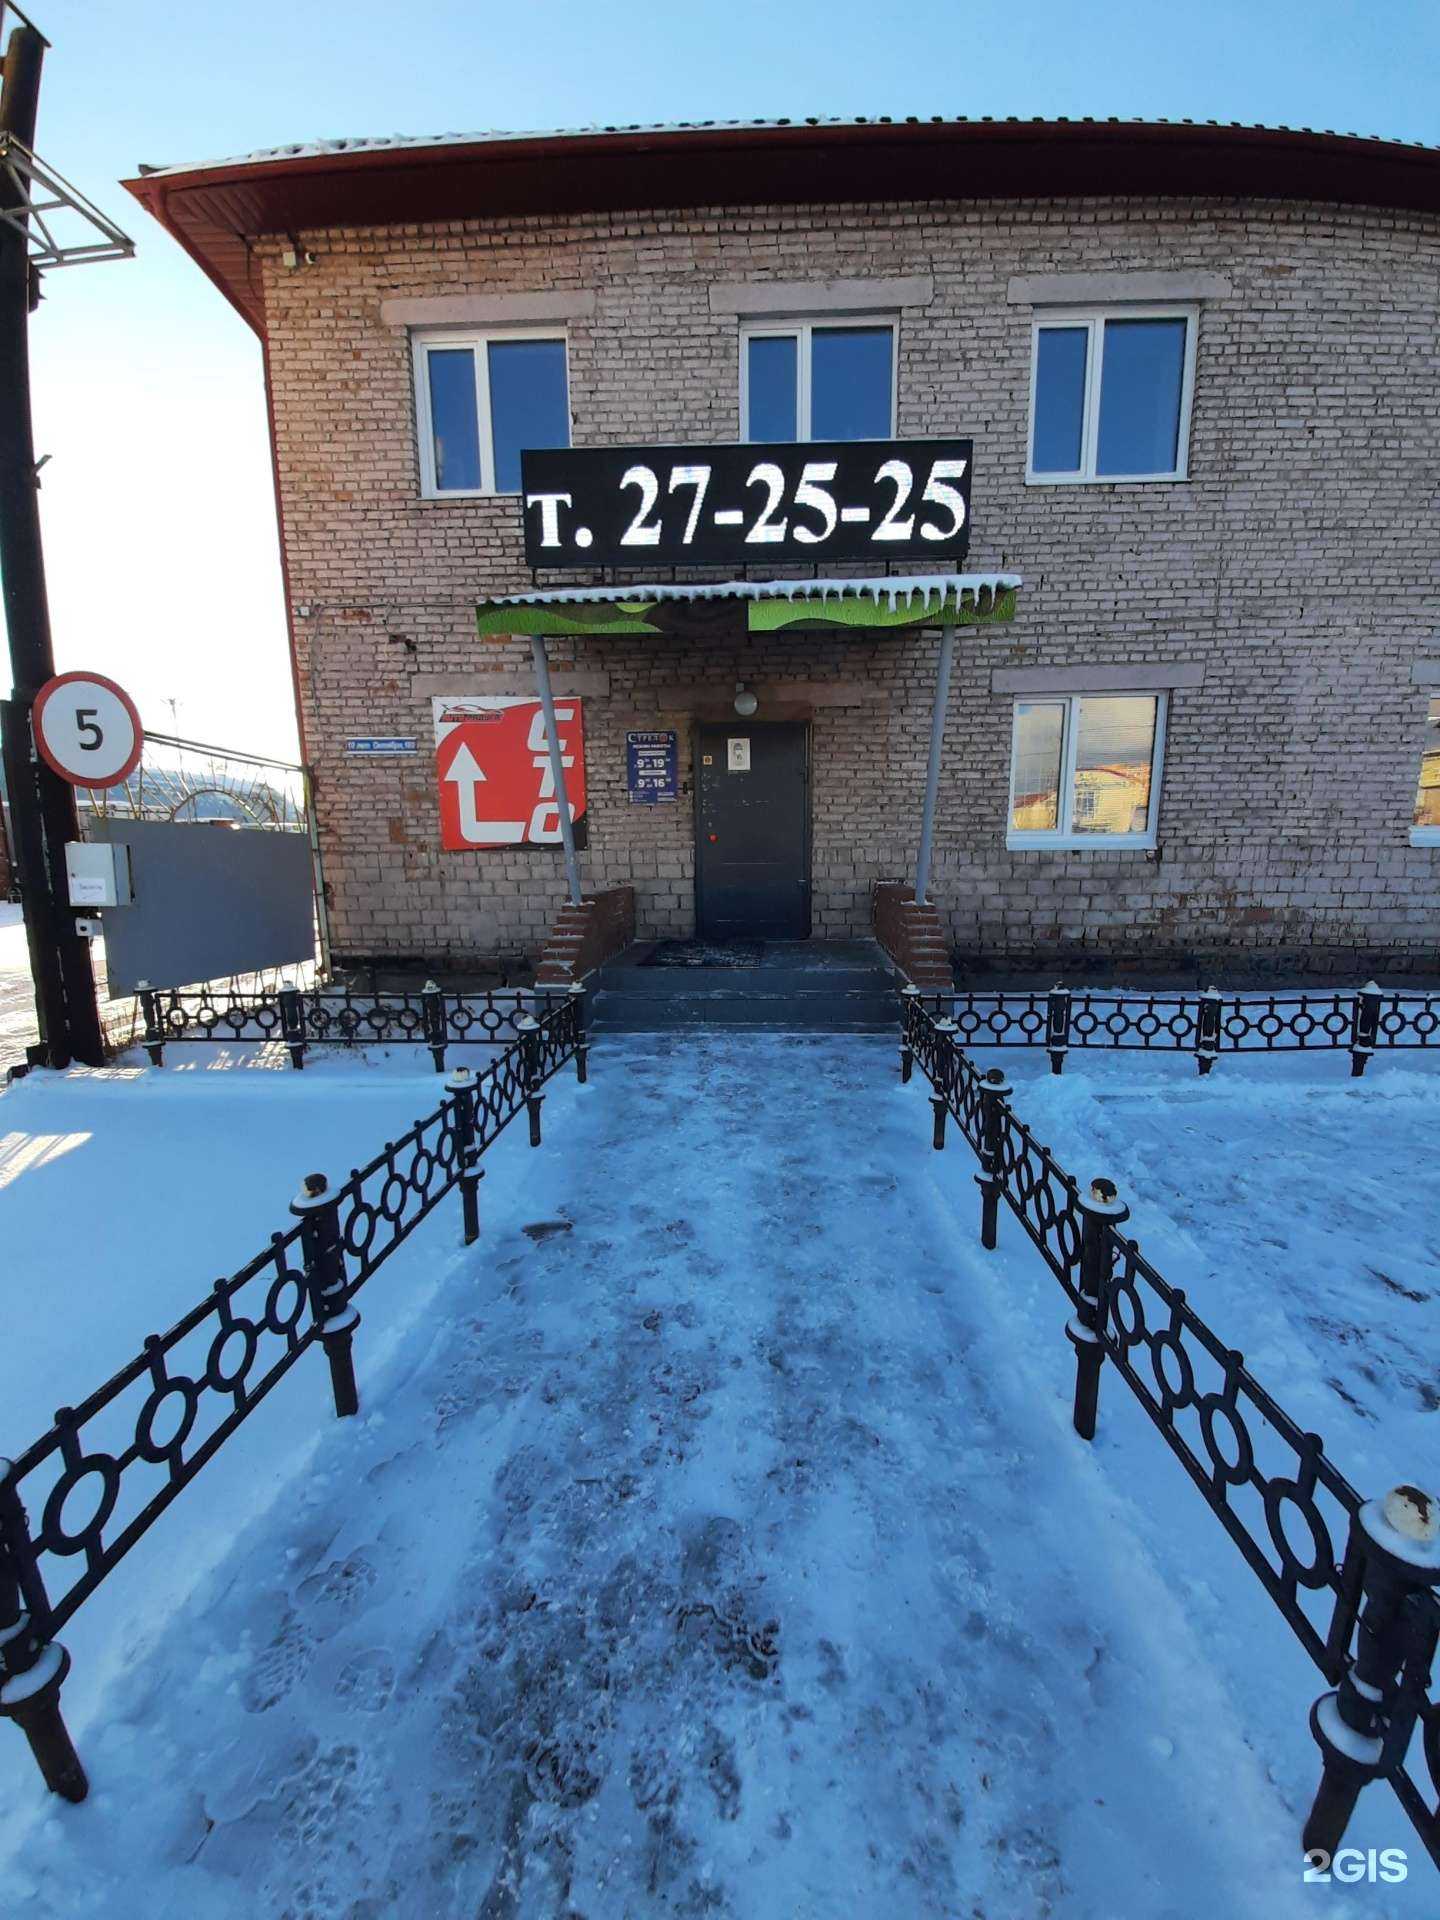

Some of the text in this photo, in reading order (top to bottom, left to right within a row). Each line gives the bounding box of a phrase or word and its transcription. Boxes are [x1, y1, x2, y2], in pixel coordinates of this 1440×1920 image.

[619, 460, 968, 545] 27-25-25
[75, 709, 104, 751] 5
[527, 708, 576, 844] СТО
